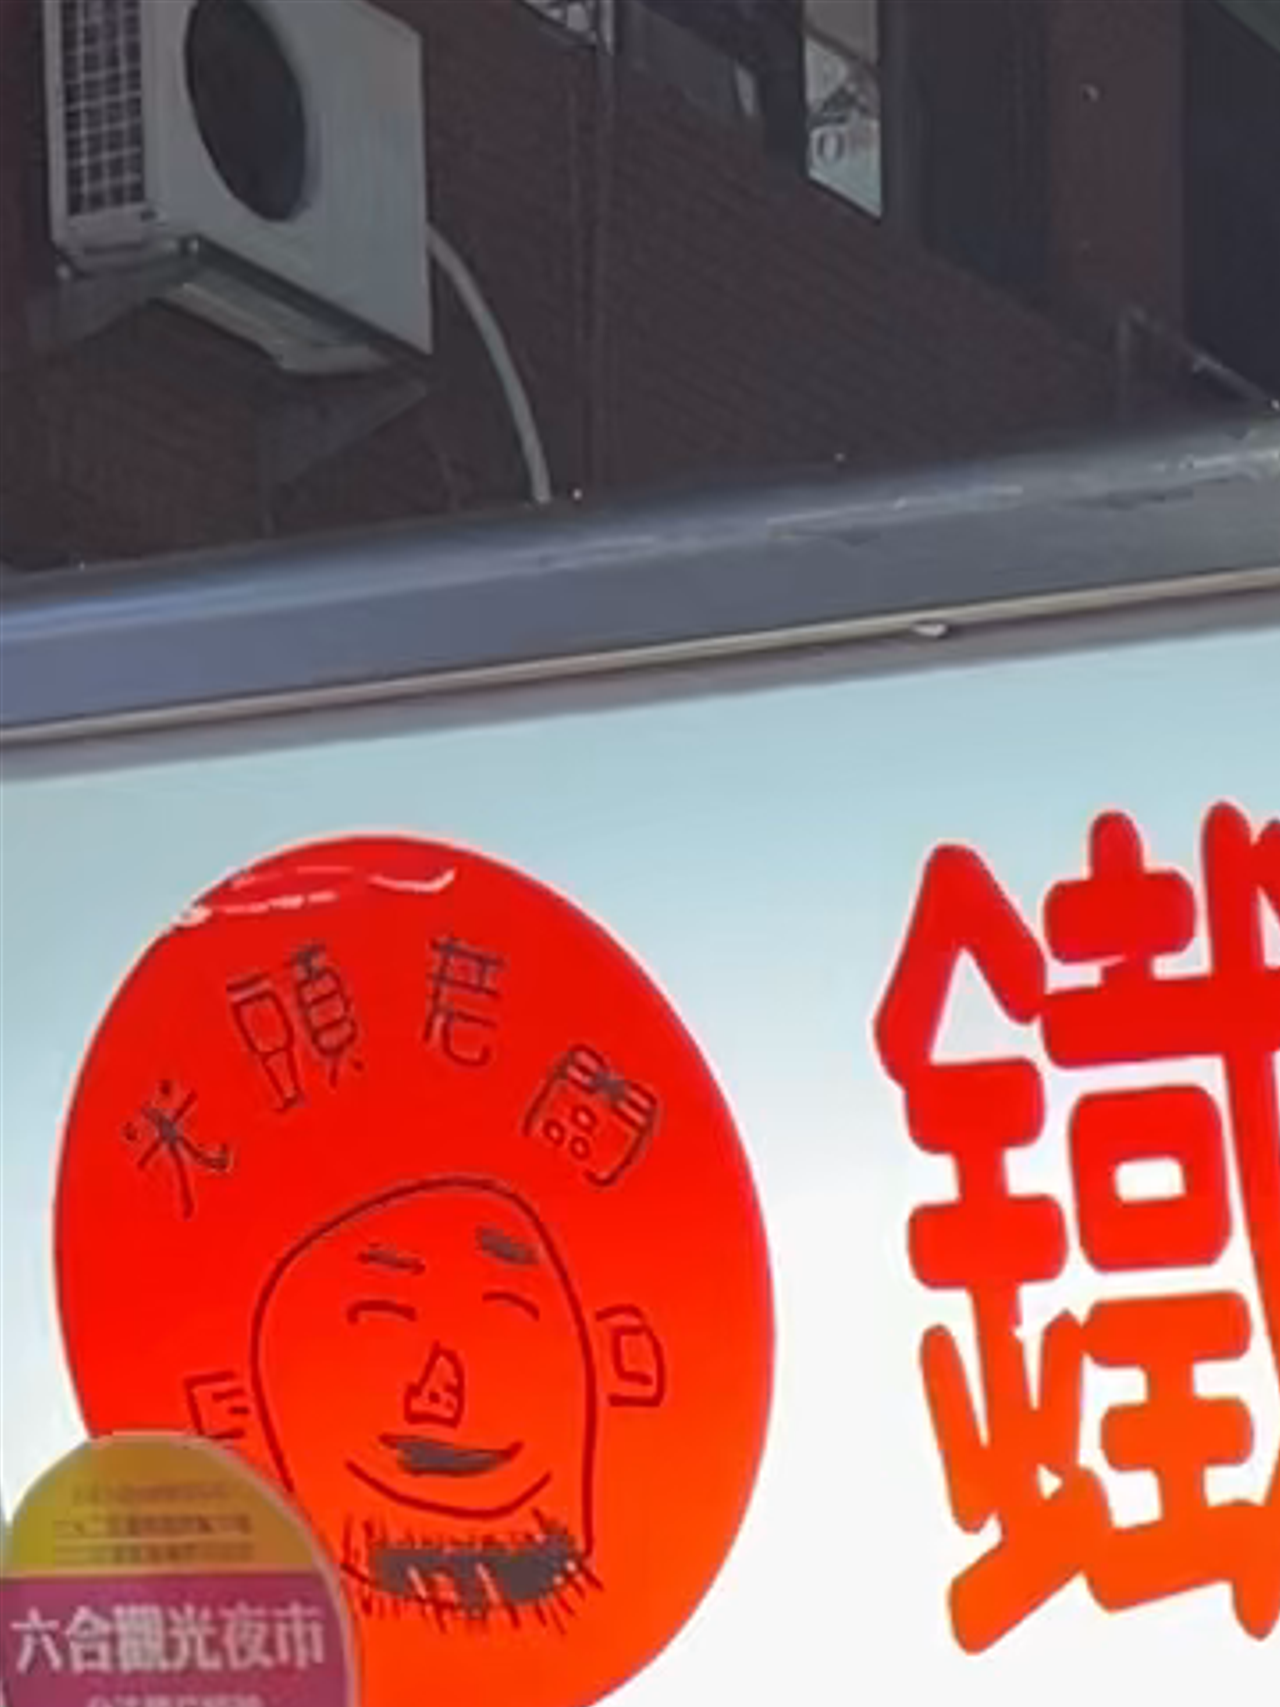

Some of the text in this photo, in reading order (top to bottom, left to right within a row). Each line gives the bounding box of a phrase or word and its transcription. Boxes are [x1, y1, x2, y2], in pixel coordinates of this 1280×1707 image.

[10, 1602, 326, 1673] 六合觀光夜市
